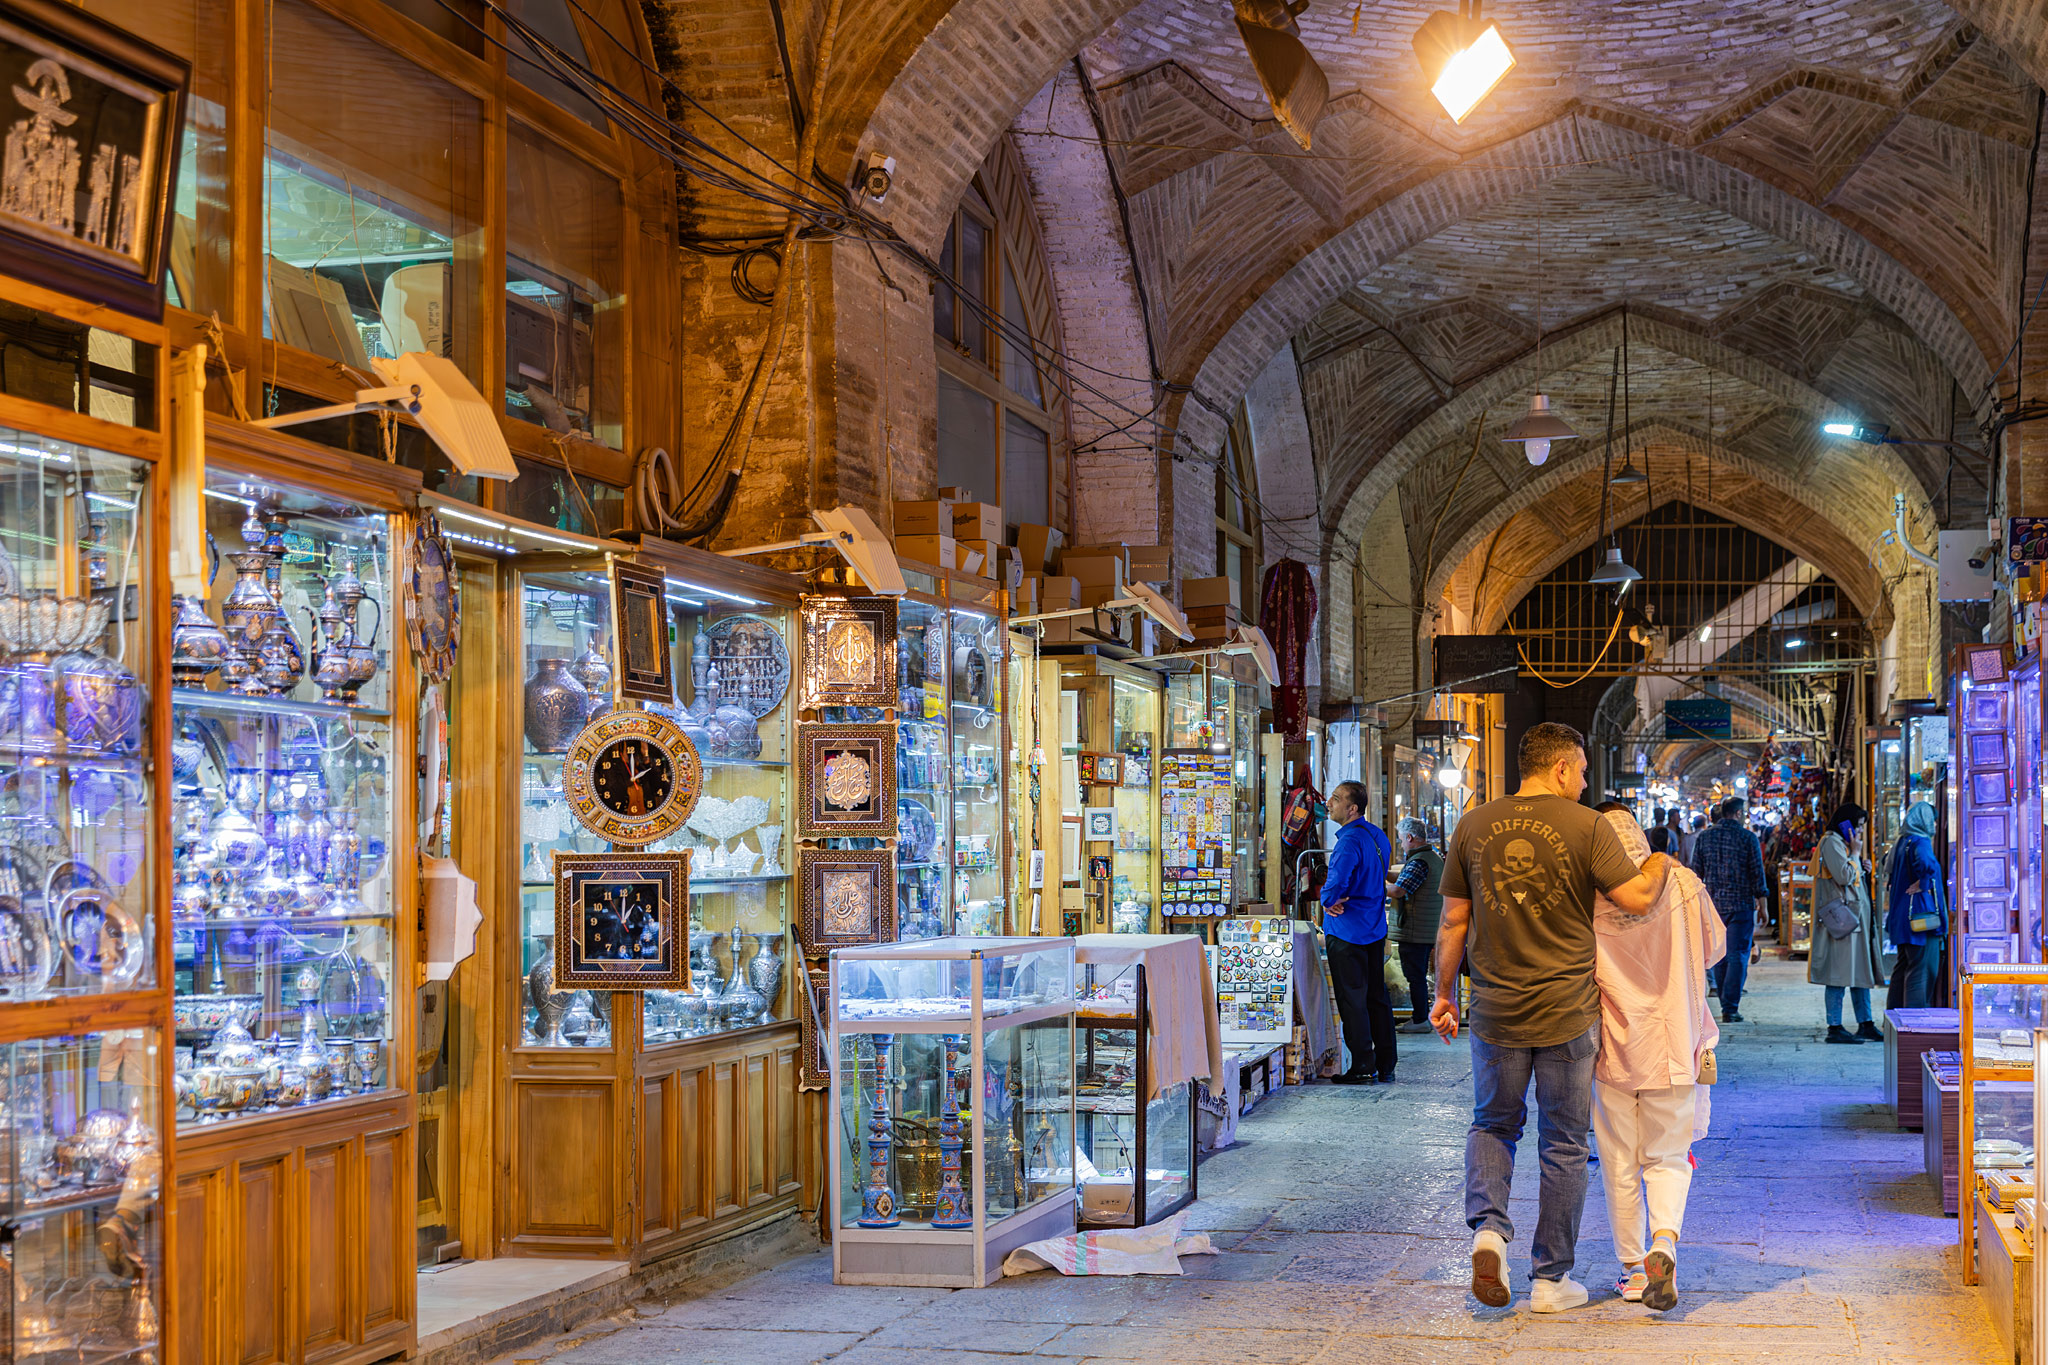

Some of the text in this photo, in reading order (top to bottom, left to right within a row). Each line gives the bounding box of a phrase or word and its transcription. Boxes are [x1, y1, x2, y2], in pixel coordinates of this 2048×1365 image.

[627, 746, 635, 754] 12
[604, 791, 610, 799] 8
[1491, 819, 1570, 863] DIFFERENT
[604, 892, 612, 900] 11
[620, 889, 628, 897] 12
[636, 893, 640, 901] 1
[1475, 879, 1508, 917] SAME
[594, 903, 602, 911] 10
[646, 904, 651, 912] 2
[595, 933, 601, 941] 8
[620, 945, 626, 953] 6
